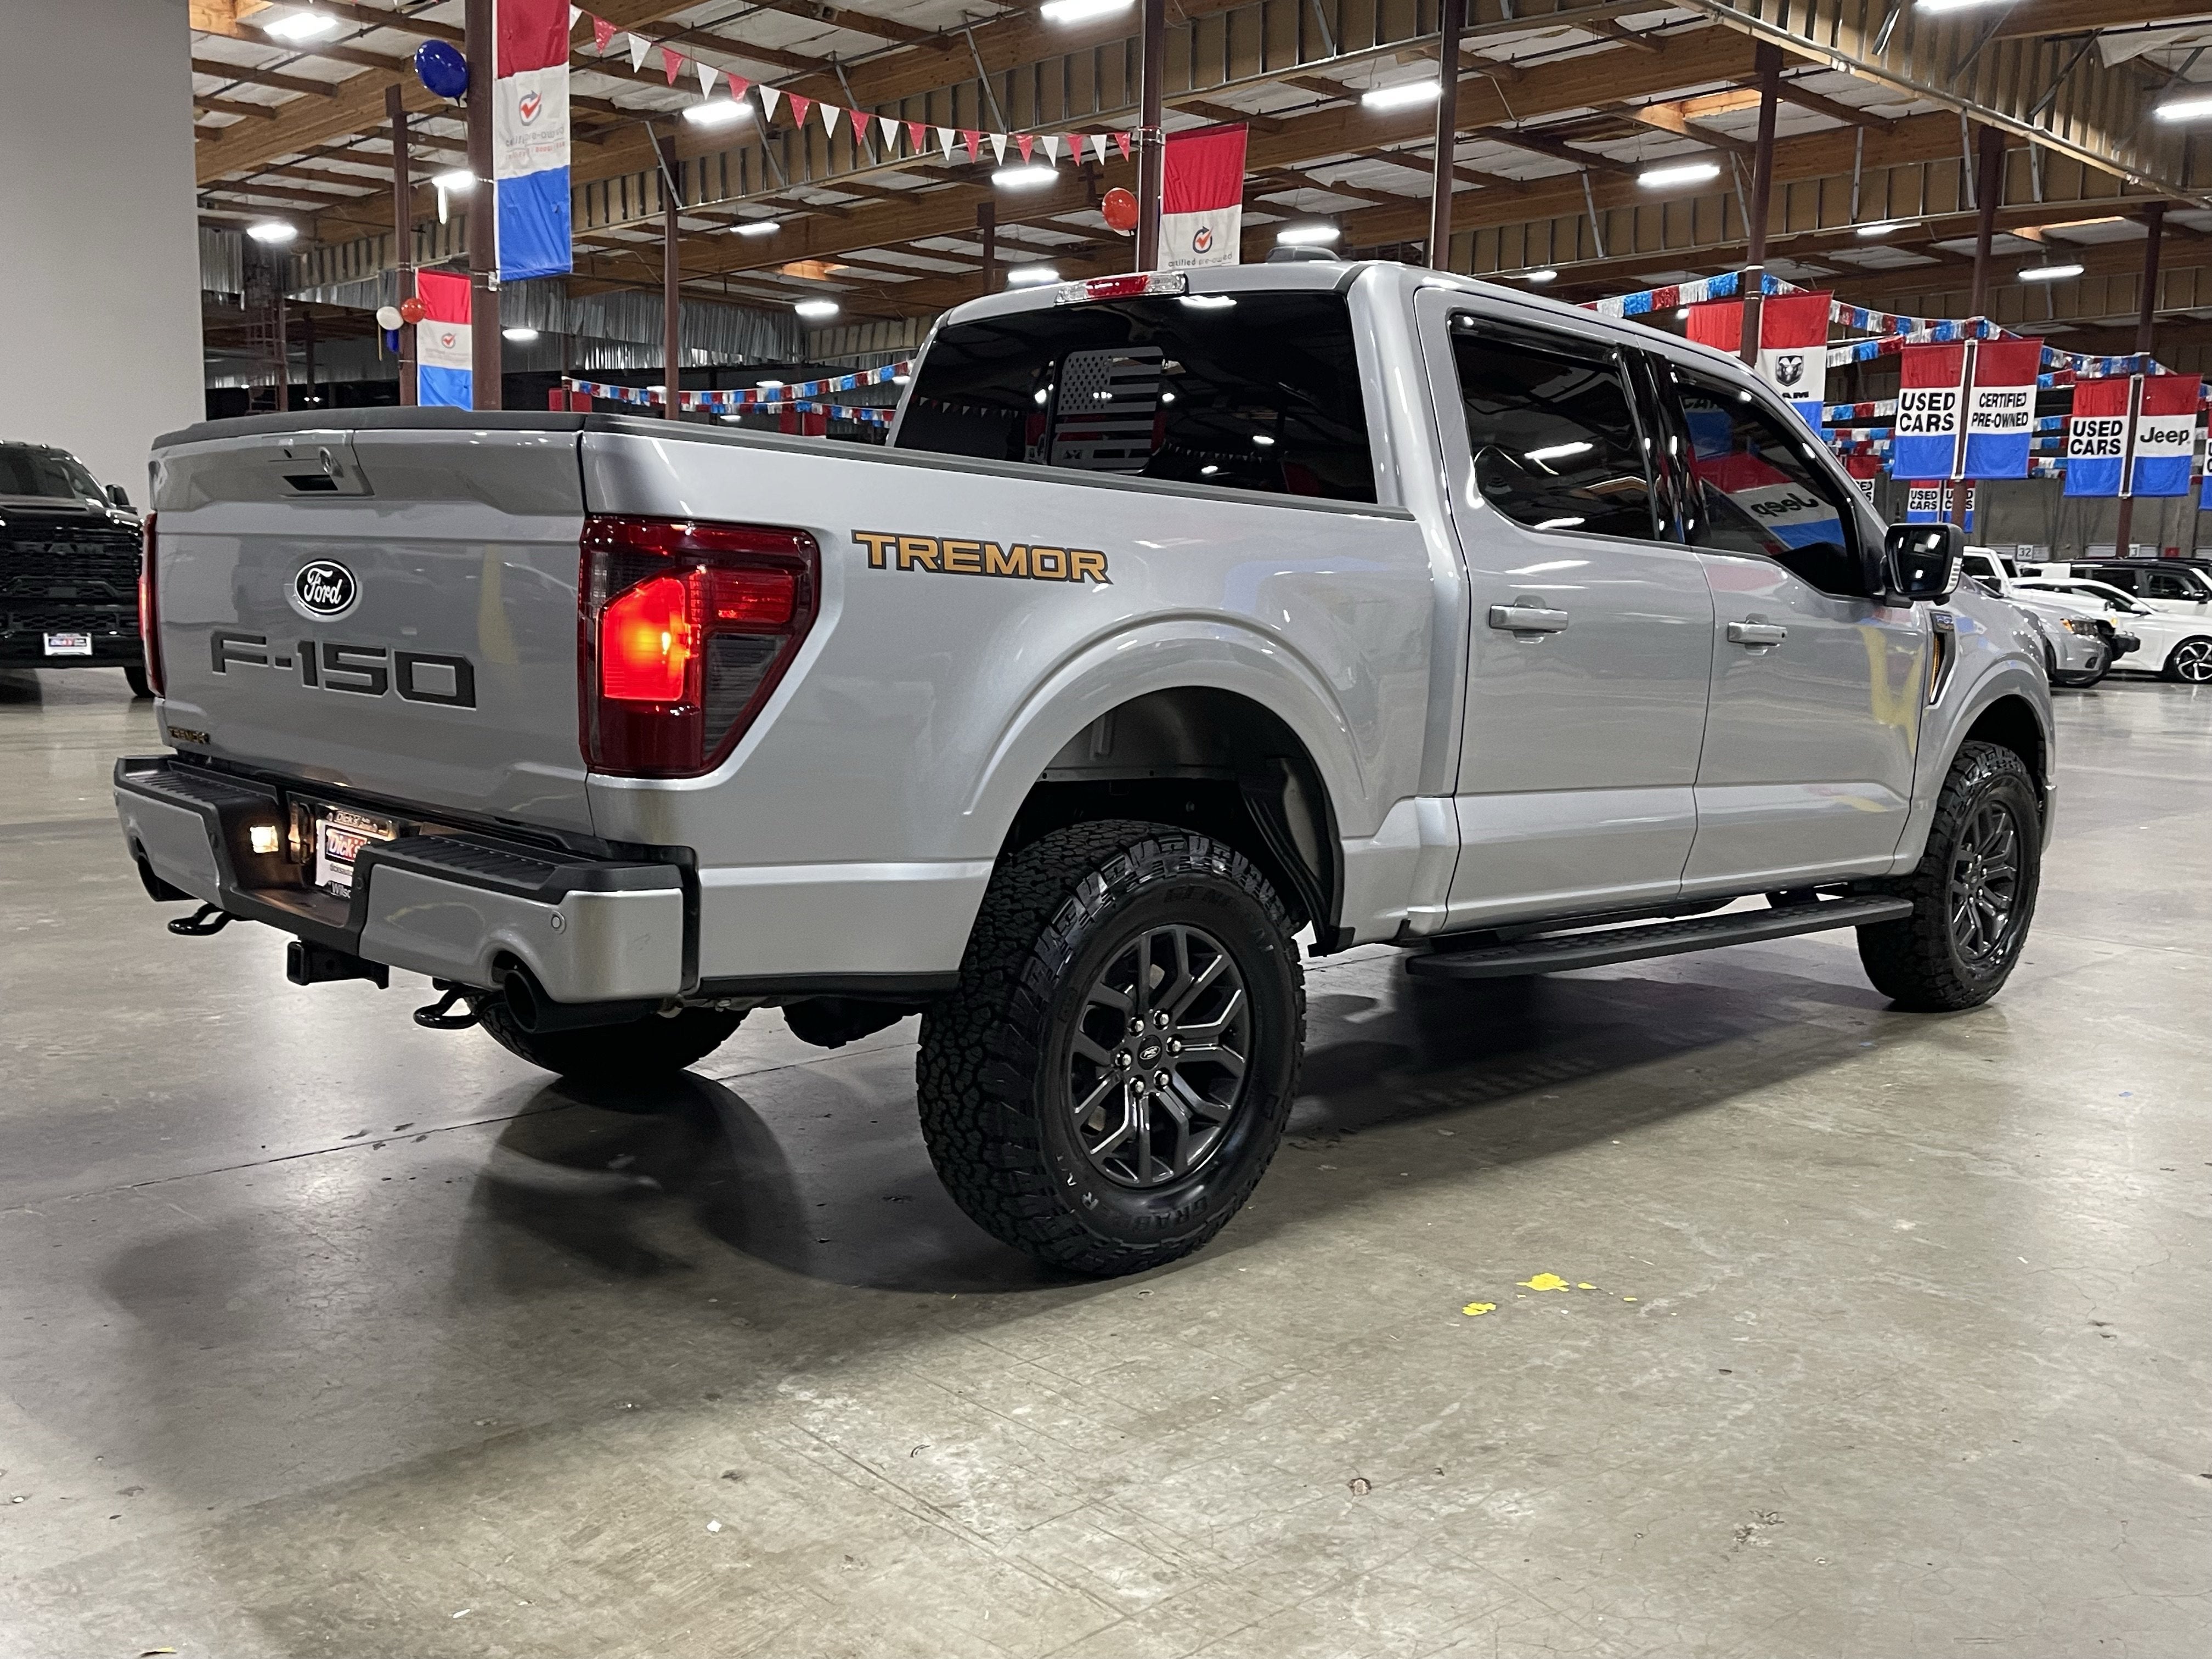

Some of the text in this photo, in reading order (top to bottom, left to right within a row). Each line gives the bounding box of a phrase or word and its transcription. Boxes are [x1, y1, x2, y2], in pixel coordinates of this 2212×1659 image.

[1781, 391, 1809, 399] AM
[1900, 392, 1956, 413] USED
[1978, 392, 2028, 409] CERTIFIED
[1899, 412, 1955, 432] CARS
[1971, 411, 2029, 429] PRE-OWNED
[2072, 419, 2123, 437] USED
[2139, 426, 2190, 445] Jeep
[2069, 437, 2123, 456] CARS
[1856, 481, 1873, 492] ED
[1911, 490, 1938, 500] USED
[1946, 490, 1973, 499] UD
[1909, 500, 1938, 510] CARS
[1944, 500, 1973, 510] CS
[851, 529, 1114, 585] TREMOR
[2018, 548, 2031, 557] 32
[303, 567, 343, 605] Ford
[210, 630, 477, 711] F-150
